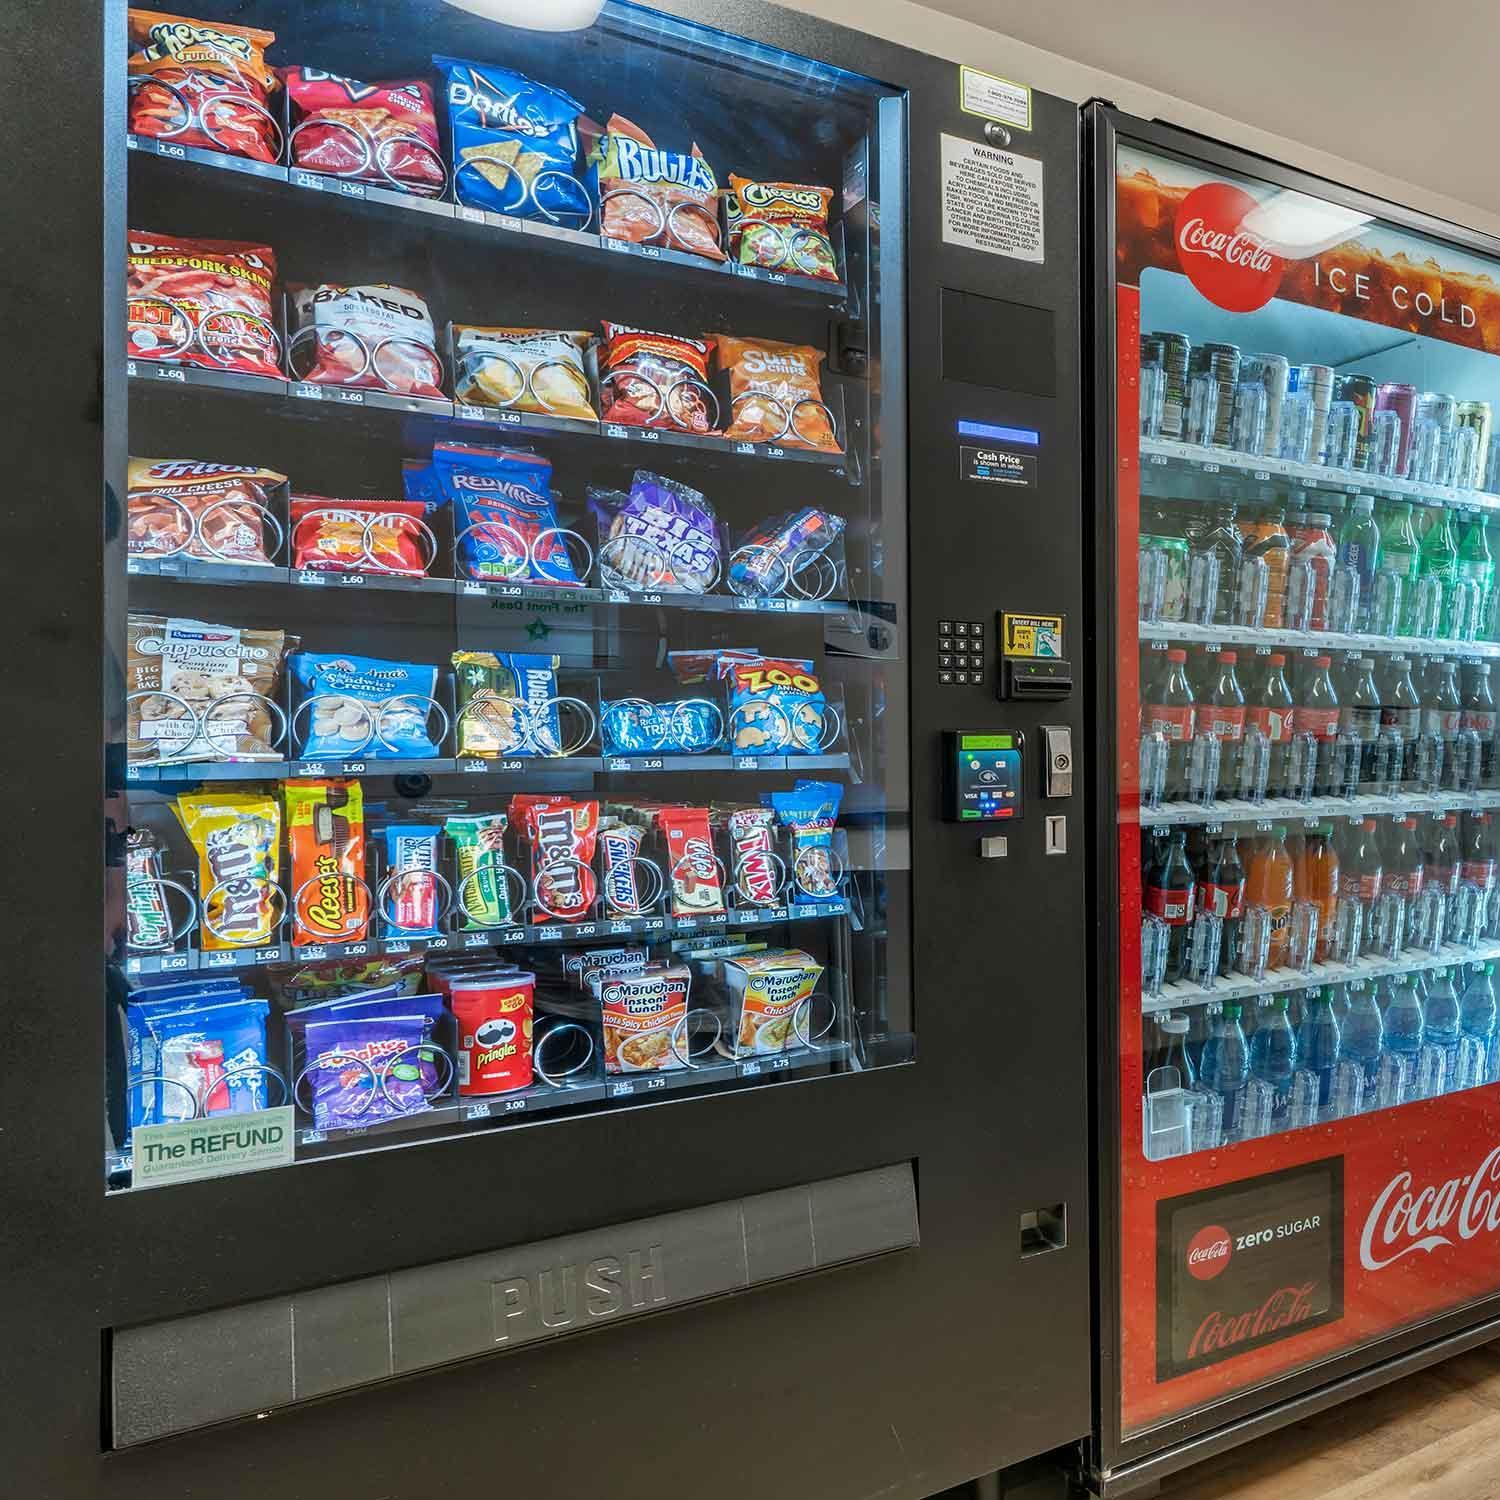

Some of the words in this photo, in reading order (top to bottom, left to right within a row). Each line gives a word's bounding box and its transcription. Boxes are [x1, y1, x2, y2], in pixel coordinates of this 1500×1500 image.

[449, 82, 553, 137] Doritos
[159, 144, 185, 158] 1.60
[973, 146, 1013, 165] WARNING
[616, 137, 716, 192] BUGLES
[743, 182, 822, 211] Cheetos
[1180, 218, 1272, 274] Coca-Cola
[641, 248, 660, 258] 1.60
[177, 257, 227, 274] PORK
[1315, 262, 1371, 301] ICE
[1392, 286, 1476, 329] COLD
[129, 305, 172, 325] HOT
[158, 369, 183, 379] 1.60
[340, 392, 362, 402] 1.60
[500, 413, 520, 423] 1.60
[641, 432, 659, 440] 1.60
[768, 448, 784, 456] 1.60
[977, 451, 998, 462] Cash
[999, 454, 1020, 465] Price
[150, 461, 257, 479] Fritos
[187, 479, 243, 493] CHEESE
[625, 516, 715, 572] TEXAS
[342, 575, 363, 584] 1.60
[502, 586, 521, 595] 1.60
[642, 595, 661, 603] 1.60
[1012, 618, 1030, 626] INSERT
[135, 636, 269, 660] Cappuccino
[136, 665, 160, 675] BIG
[136, 681, 160, 690] BAG
[326, 673, 396, 688] Sandwich
[739, 669, 820, 694] ZOO
[330, 681, 393, 692] Cremes
[343, 763, 365, 773] 1.60
[503, 761, 522, 769] 1.60
[644, 760, 662, 768] 1.60
[737, 829, 773, 901] TWIX
[608, 839, 635, 907] SNICKERS
[308, 854, 342, 930] Reese's
[771, 910, 787, 918] 1.60
[646, 920, 663, 929] 1.60
[577, 926, 595, 935] 1.60
[505, 932, 524, 941] 1.60
[427, 939, 447, 948] 1.60
[255, 951, 279, 960] 1.60
[344, 946, 366, 955] 1.60
[161, 958, 187, 968] 1.60
[582, 952, 642, 966] Maruchan
[765, 972, 816, 985] Maruchan
[620, 982, 684, 997] Maruchan
[768, 983, 802, 994] Instant
[624, 996, 667, 1006] Instant
[771, 992, 796, 1002] Lunch
[629, 1004, 663, 1014] Lunch
[622, 1018, 641, 1029] Spicy
[642, 1015, 670, 1029] Chicken
[477, 1043, 518, 1068] Pringles
[773, 1060, 788, 1068] 1.75
[505, 1101, 525, 1110] 3.00
[143, 1143, 186, 1162] The
[191, 1127, 284, 1155] REFUND
[1188, 1239, 1231, 1265] Coca-Cola
[1236, 1228, 1274, 1251] zero
[1276, 1215, 1321, 1240] SUGAR
[490, 1245, 667, 1342] PUSH
